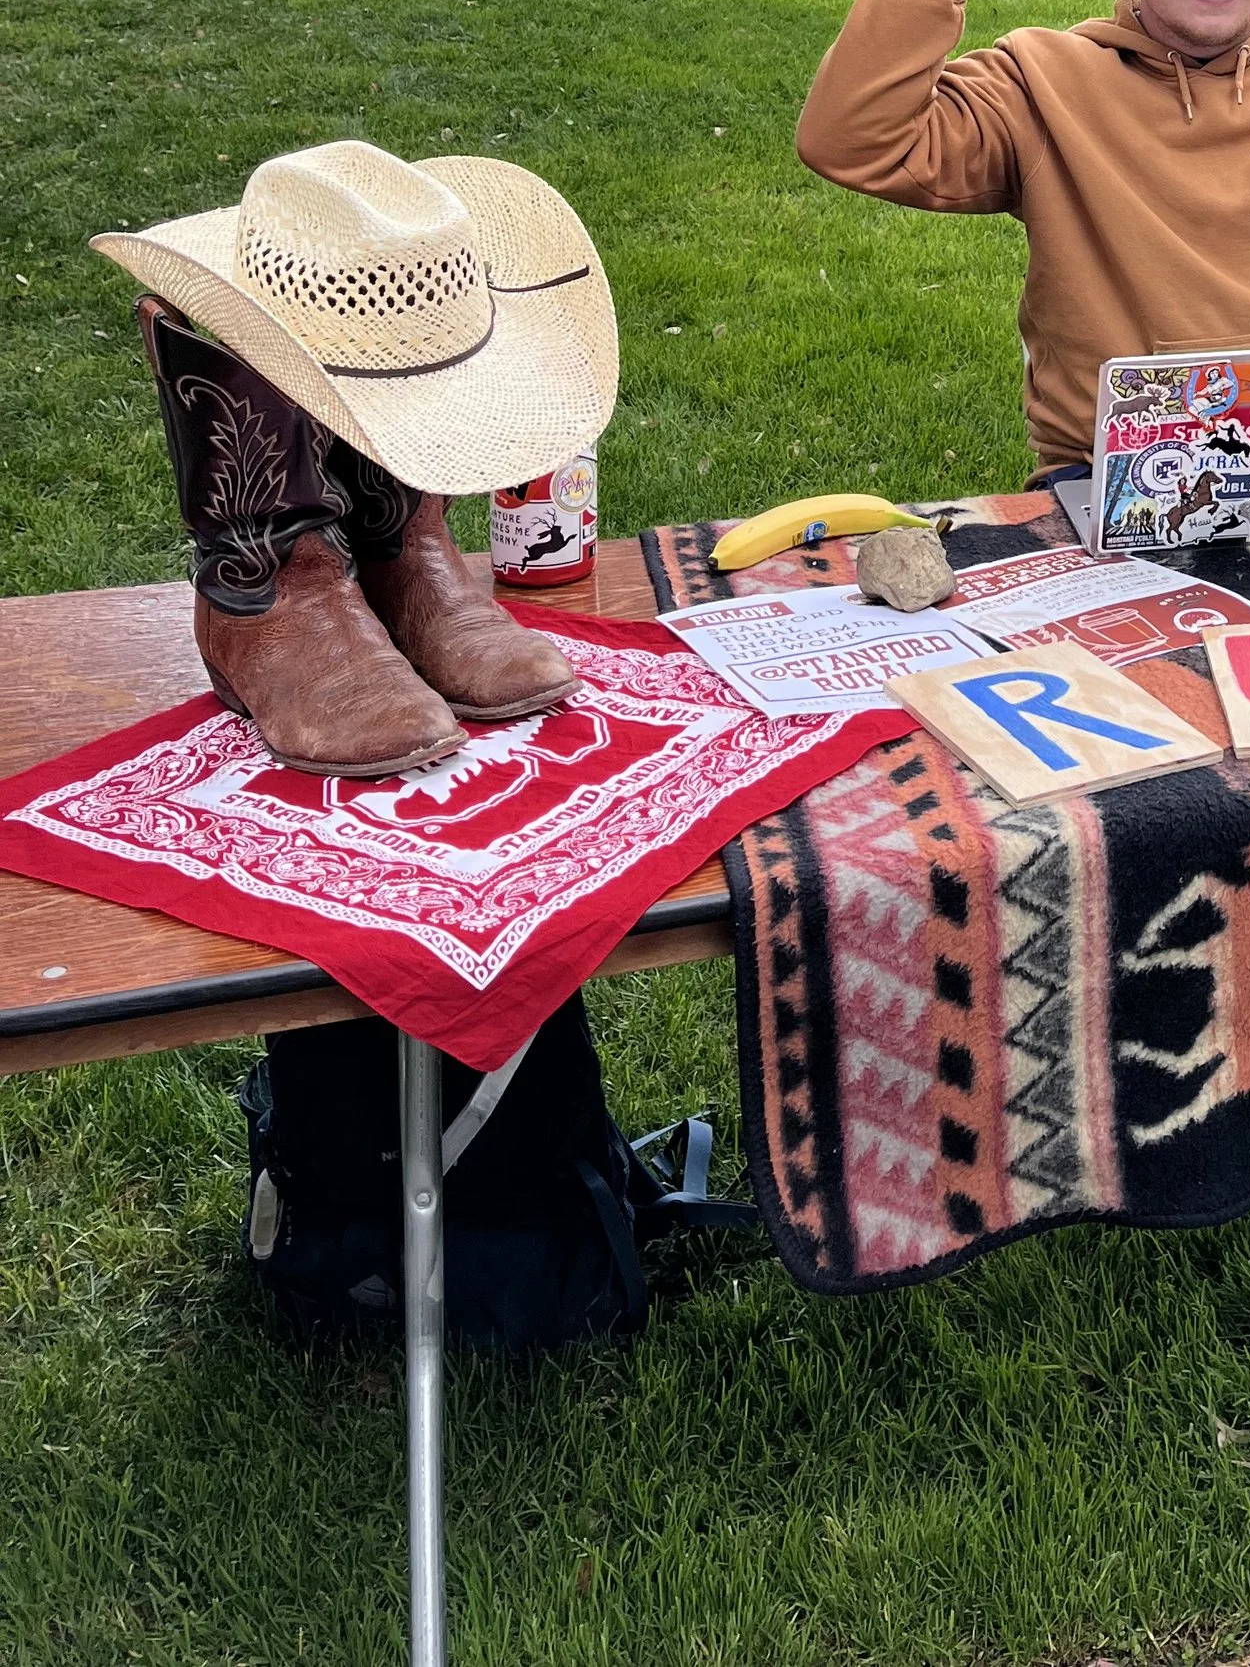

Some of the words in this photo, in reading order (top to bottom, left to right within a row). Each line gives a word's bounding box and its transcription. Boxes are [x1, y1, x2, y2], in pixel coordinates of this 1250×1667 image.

[1133, 443, 1166, 479] UNIVERSITY
[1167, 441, 1180, 449] OF
[1158, 495, 1177, 509] Yee
[492, 520, 510, 534] AKES
[515, 527, 530, 537] ME
[1106, 535, 1134, 544] MONTANA
[956, 569, 1005, 584] PRING
[1006, 551, 1078, 572] QUARTER
[964, 559, 1099, 600] SCHEDULE
[998, 555, 1087, 583] DANCIN
[688, 604, 783, 627] FOLLOW:
[706, 608, 844, 635] STANFORD
[714, 625, 802, 644] RURAL
[722, 620, 900, 652] ENGAGEMENT
[730, 630, 864, 661] NETWORK
[750, 635, 954, 682] @STANFORD
[594, 697, 704, 723] STANFORD
[490, 789, 600, 859] STANFORD
[601, 733, 702, 793] CARDINAL
